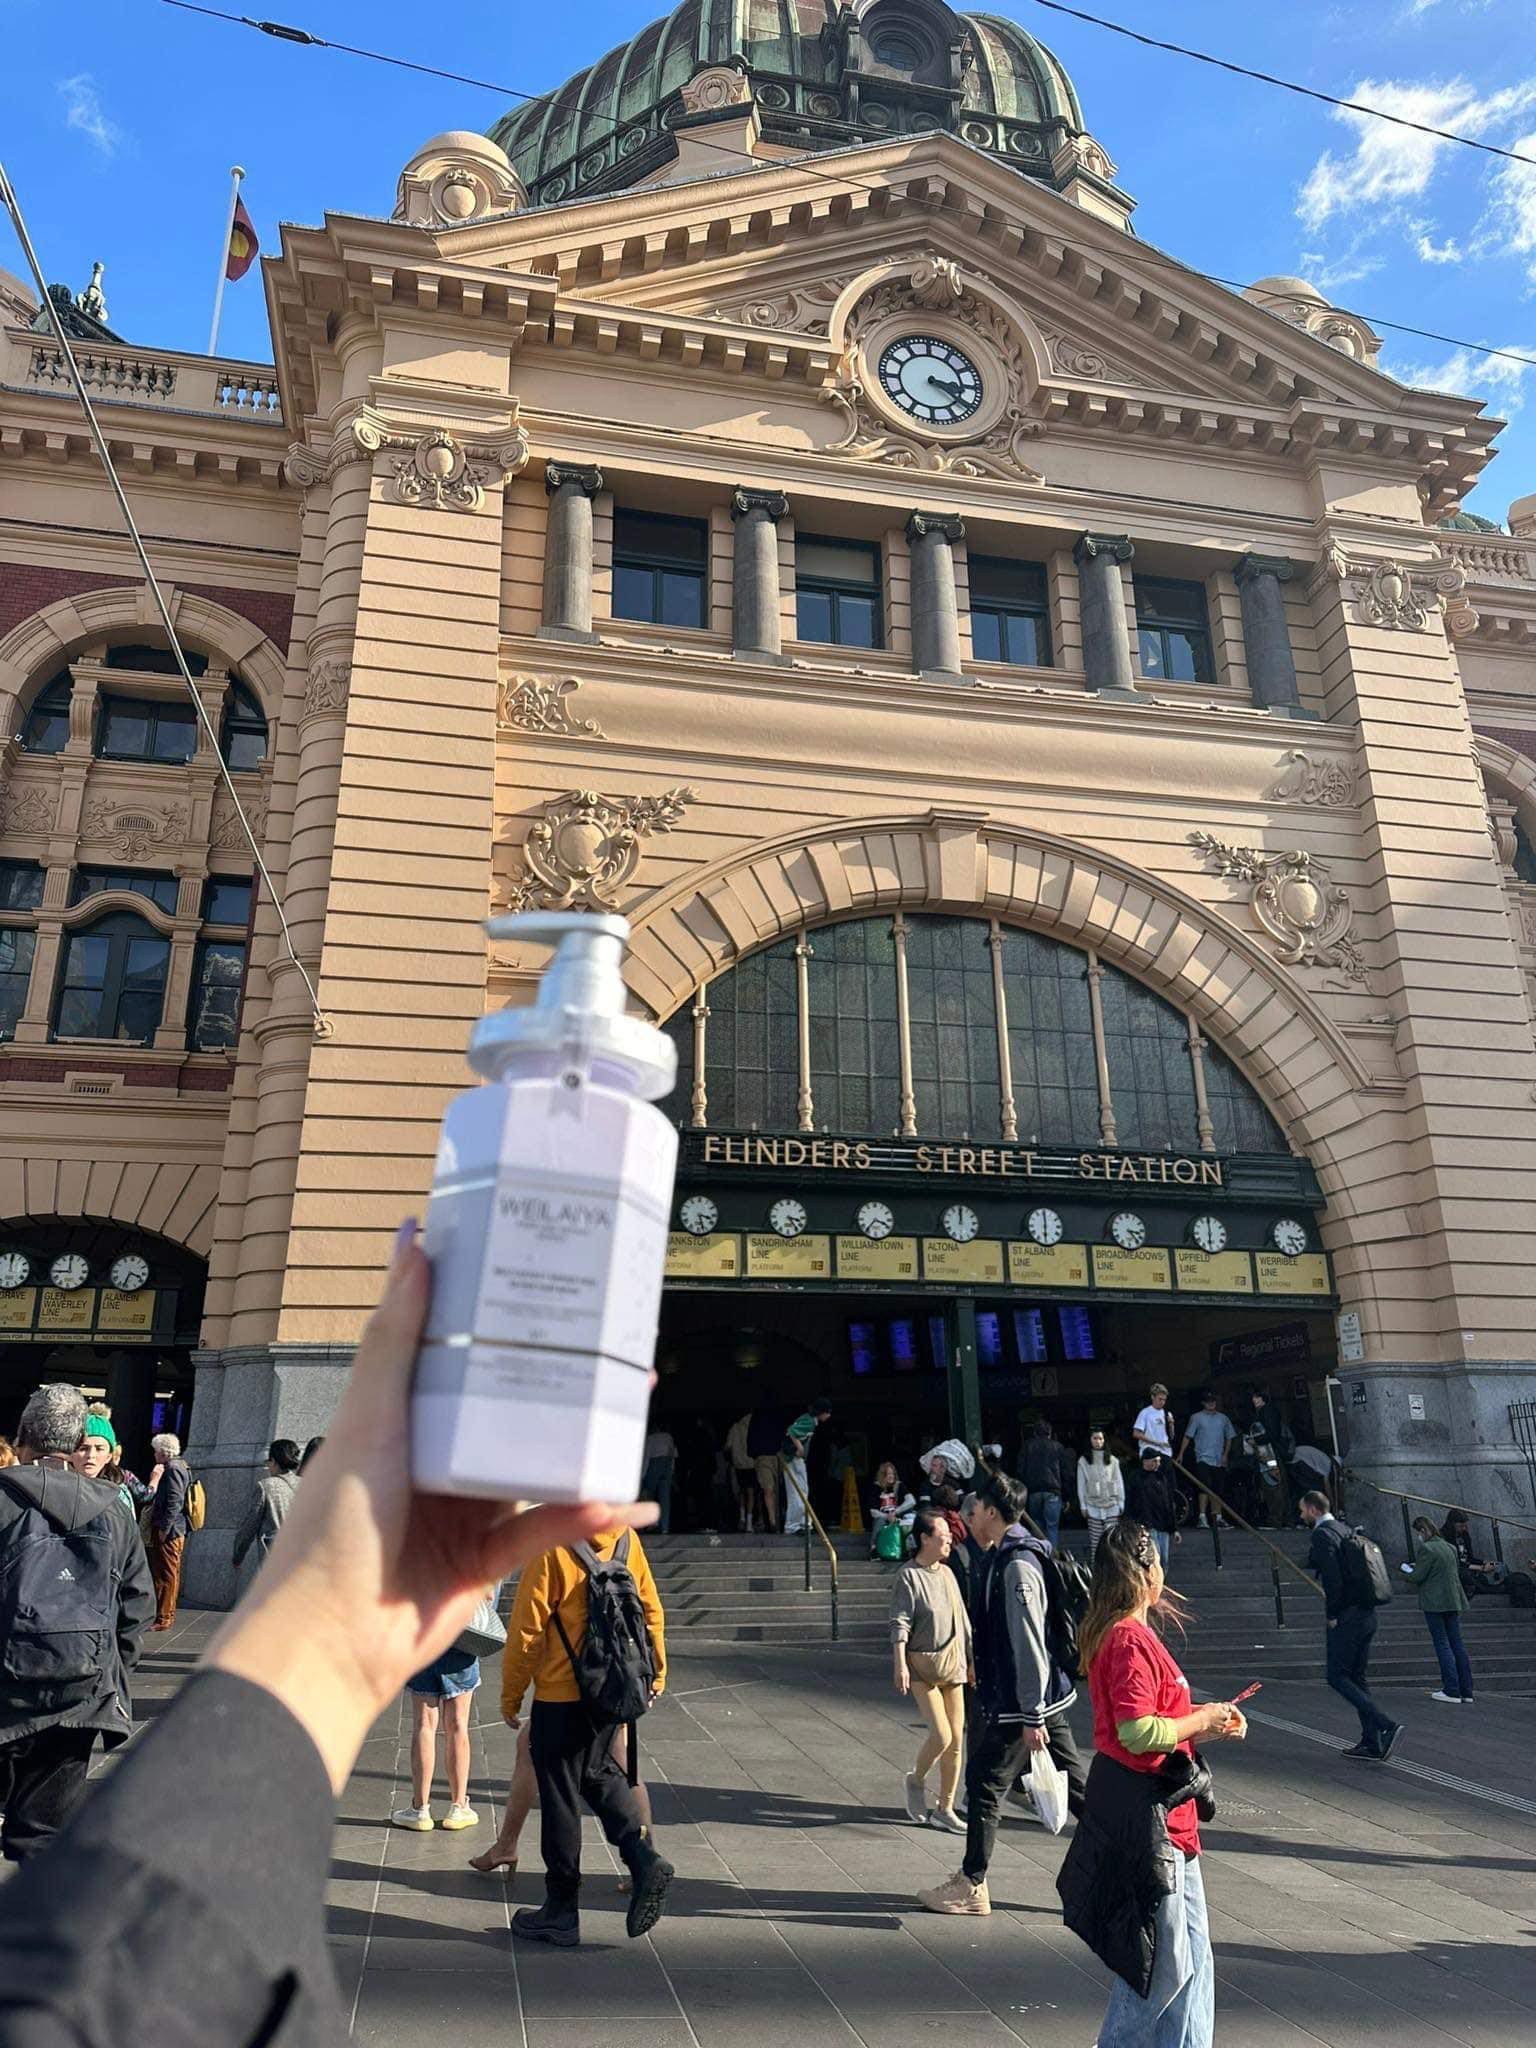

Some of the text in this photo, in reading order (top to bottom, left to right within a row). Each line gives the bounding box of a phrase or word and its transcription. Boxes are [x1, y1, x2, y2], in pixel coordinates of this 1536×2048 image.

[703, 1136, 1223, 1186] FLINDERS STREET STATION
[670, 1236, 711, 1247] ANKSTON
[751, 1237, 813, 1248] SANDRINGHAM
[840, 1239, 904, 1250] WILLIAMSTOWN
[927, 1241, 960, 1252] ALTONA
[751, 1249, 770, 1260] LINE
[840, 1251, 860, 1261] LINE
[1024, 1247, 1056, 1257] ALBANS
[1095, 1249, 1164, 1261] BROADMEADOWS
[1178, 1252, 1211, 1263] UPFIELD
[927, 1253, 946, 1263] LINE
[1012, 1257, 1031, 1267] LINE
[1096, 1261, 1115, 1271] LINE
[1180, 1264, 1198, 1274] LINE
[1260, 1267, 1278, 1277] LINE
[44, 1291, 67, 1301] GLEN
[43, 1299, 88, 1310] WAVERLEY
[102, 1301, 121, 1311] LINE
[41, 1307, 61, 1318] LINE
